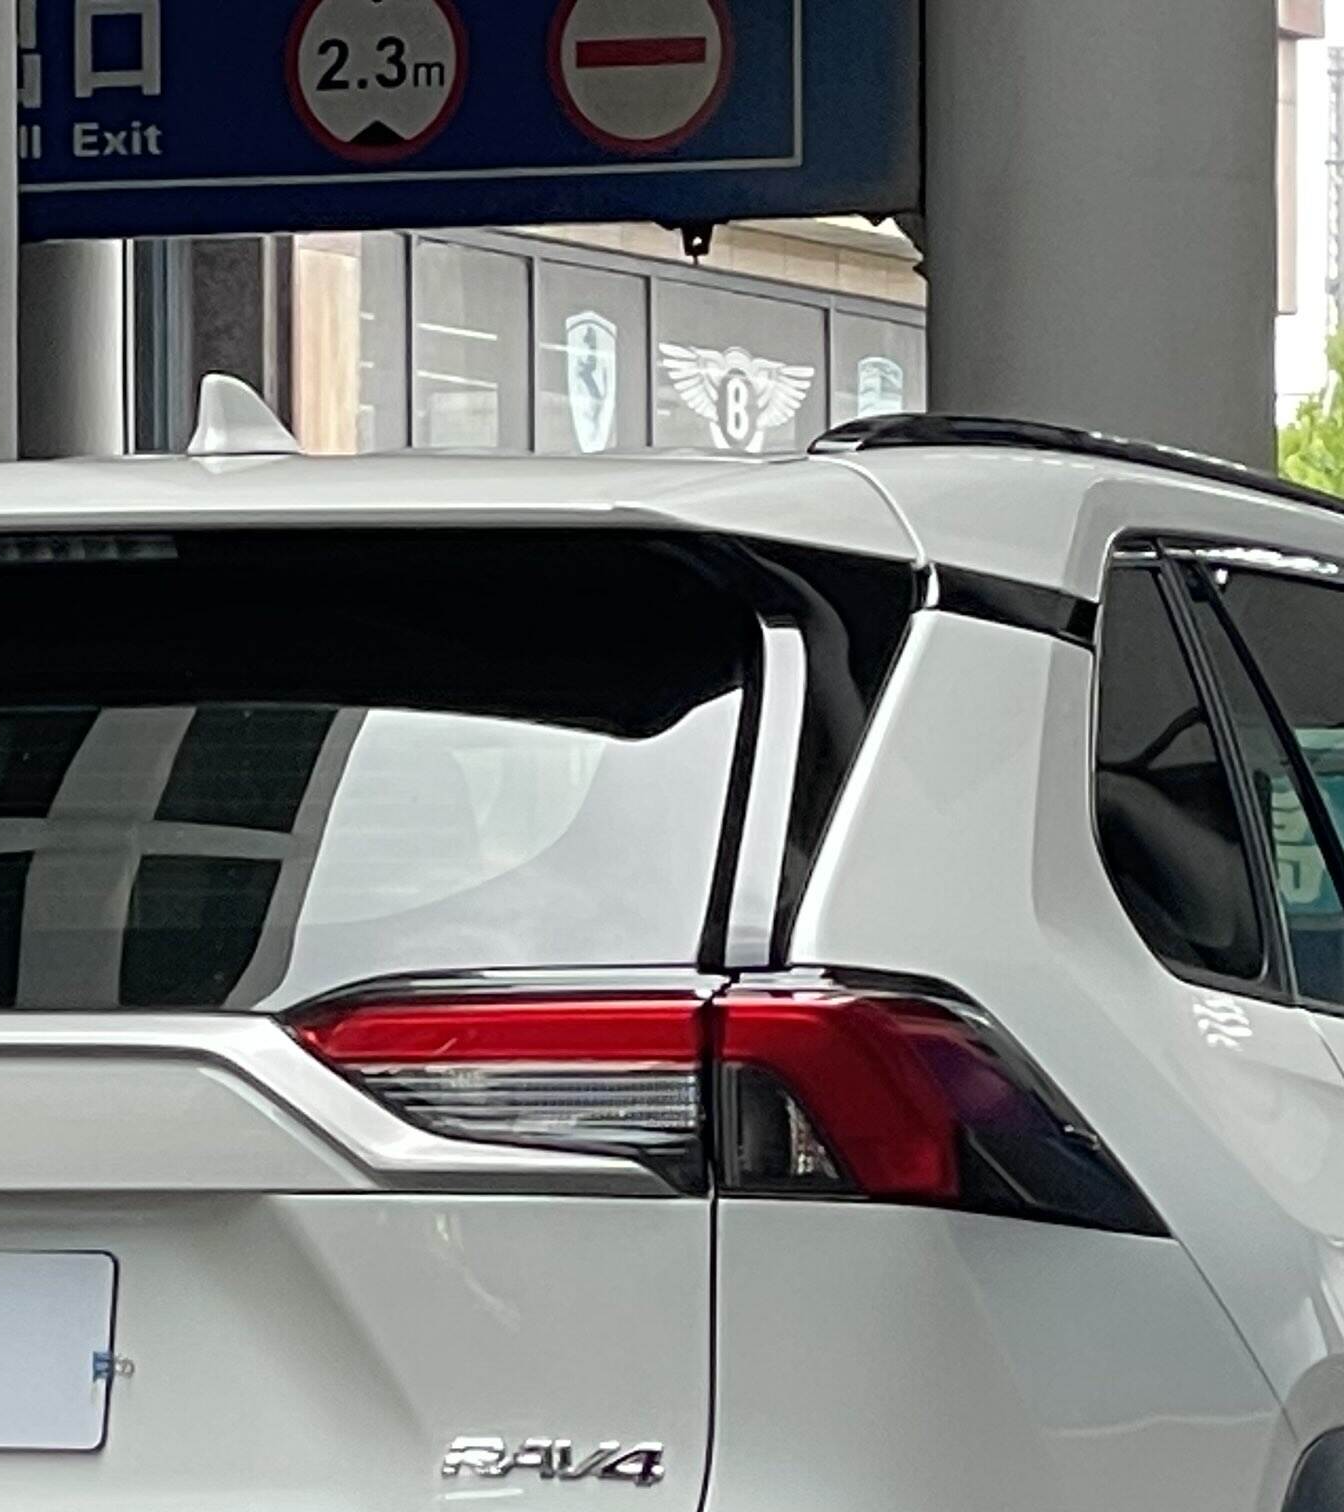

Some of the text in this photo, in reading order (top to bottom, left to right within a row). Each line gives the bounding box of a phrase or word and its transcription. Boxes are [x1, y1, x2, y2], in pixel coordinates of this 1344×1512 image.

[316, 36, 445, 91] 2.3m
[73, 120, 162, 157] Exit
[441, 1435, 665, 1487] RAV4
